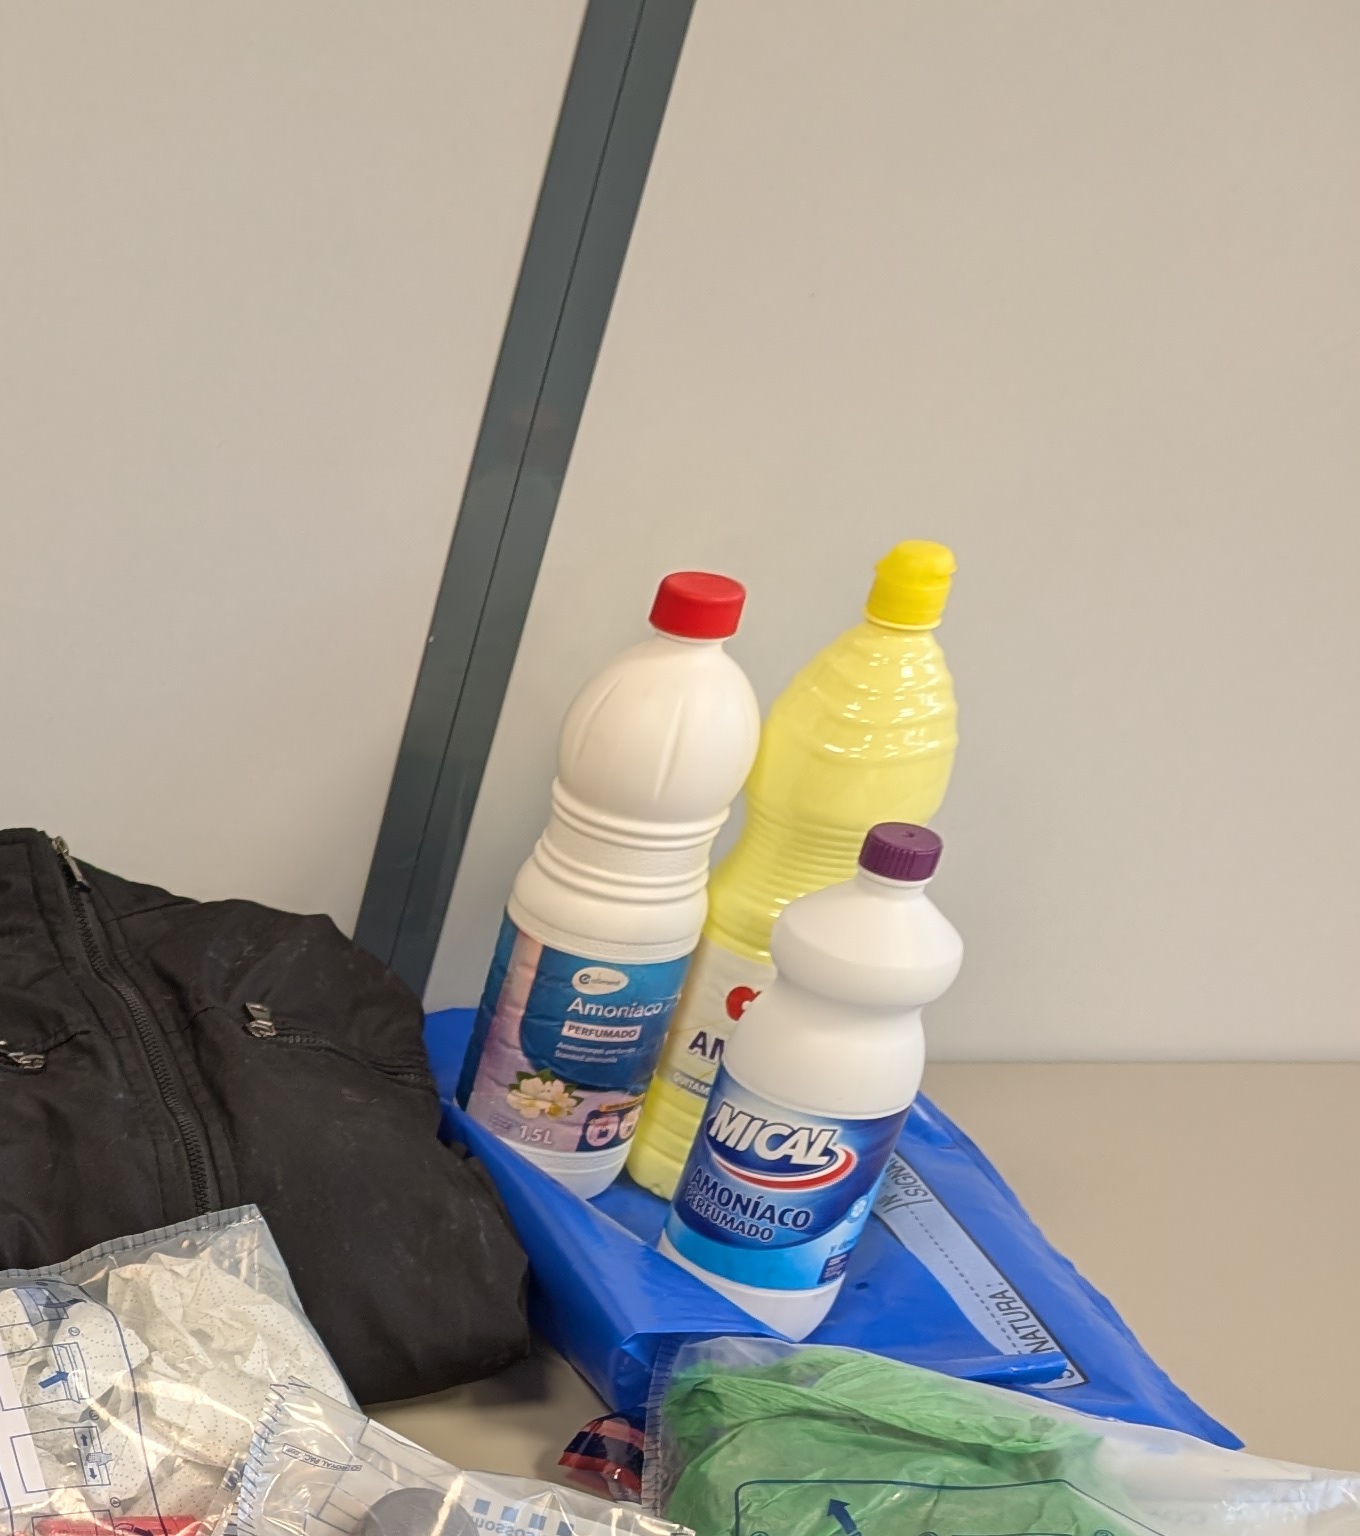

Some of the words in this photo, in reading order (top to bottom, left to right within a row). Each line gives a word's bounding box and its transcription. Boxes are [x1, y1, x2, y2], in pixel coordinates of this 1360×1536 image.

[566, 1023, 638, 1039] PERFUMADO
[708, 1101, 839, 1166] MICAL
[685, 1185, 774, 1242] PERFUMADO
[690, 1167, 812, 1230] AMONÍACO
